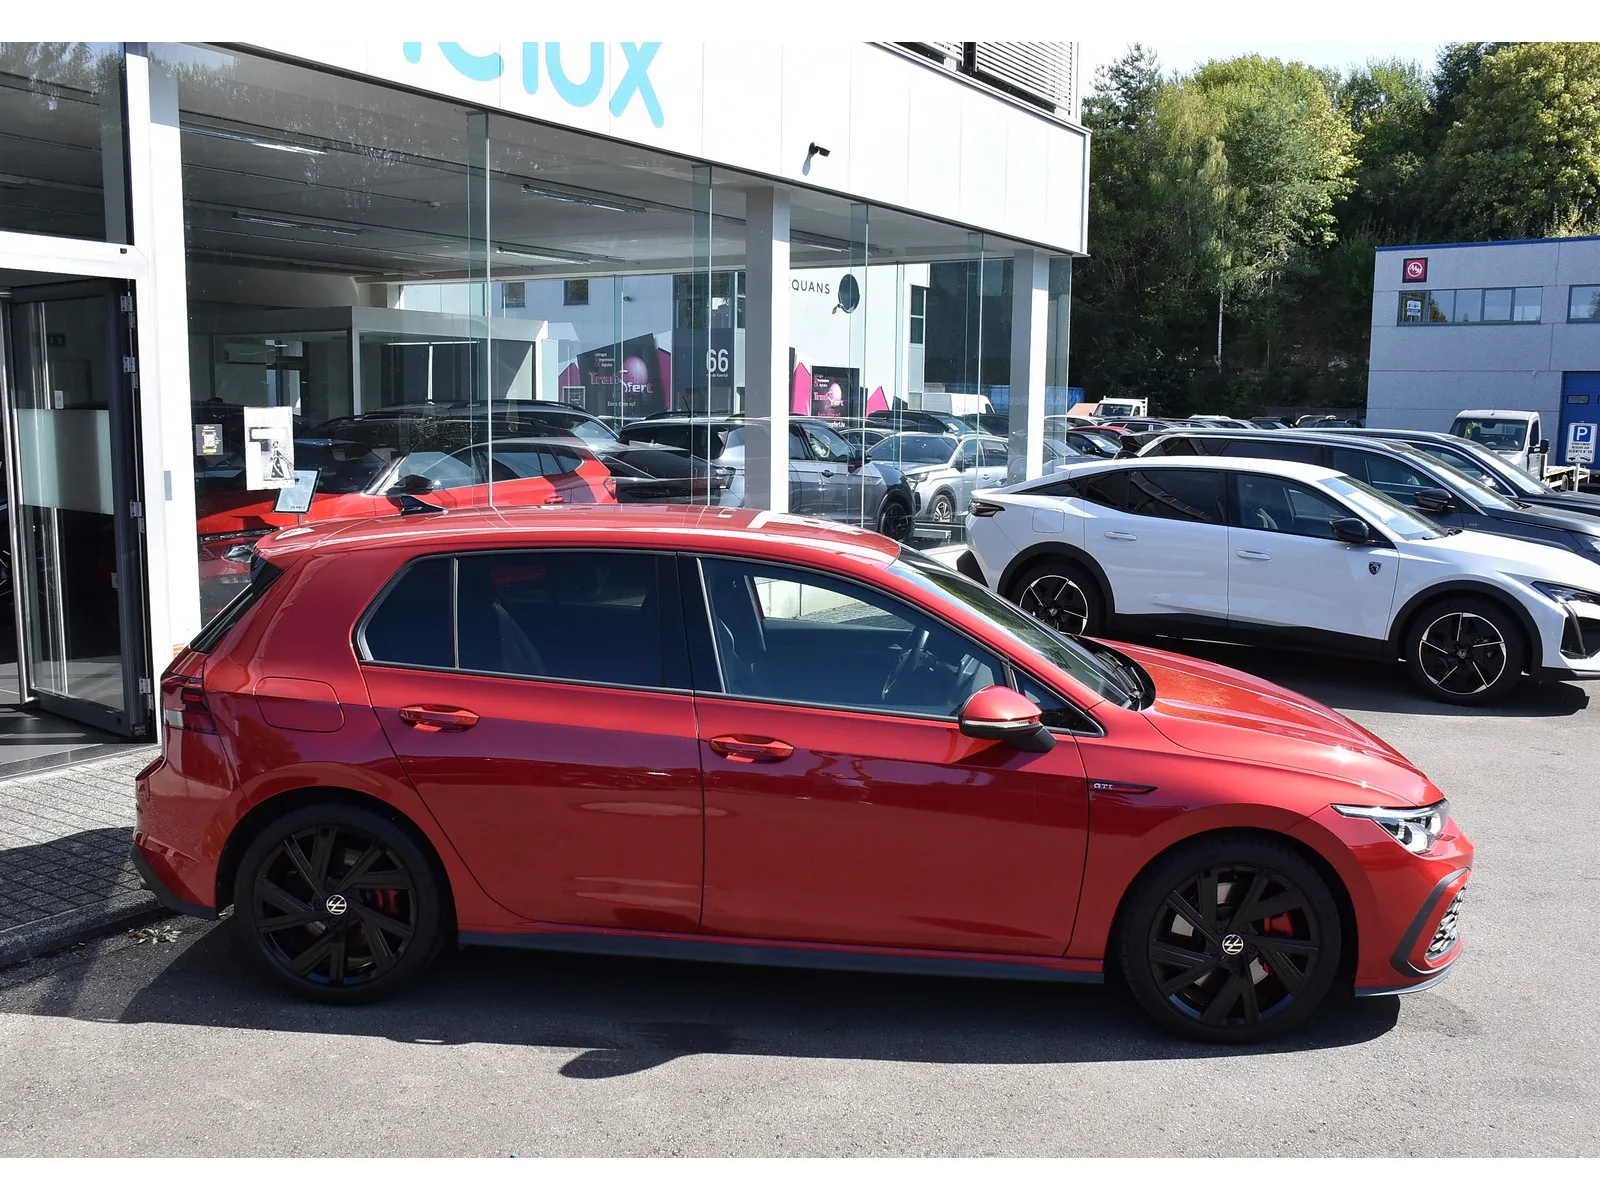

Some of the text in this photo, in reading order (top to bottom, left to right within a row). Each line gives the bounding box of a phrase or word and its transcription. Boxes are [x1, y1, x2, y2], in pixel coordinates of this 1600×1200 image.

[789, 278, 830, 295] QUANS
[706, 348, 729, 373] 66
[1576, 426, 1588, 441] P
[1093, 782, 1113, 790] GTI
